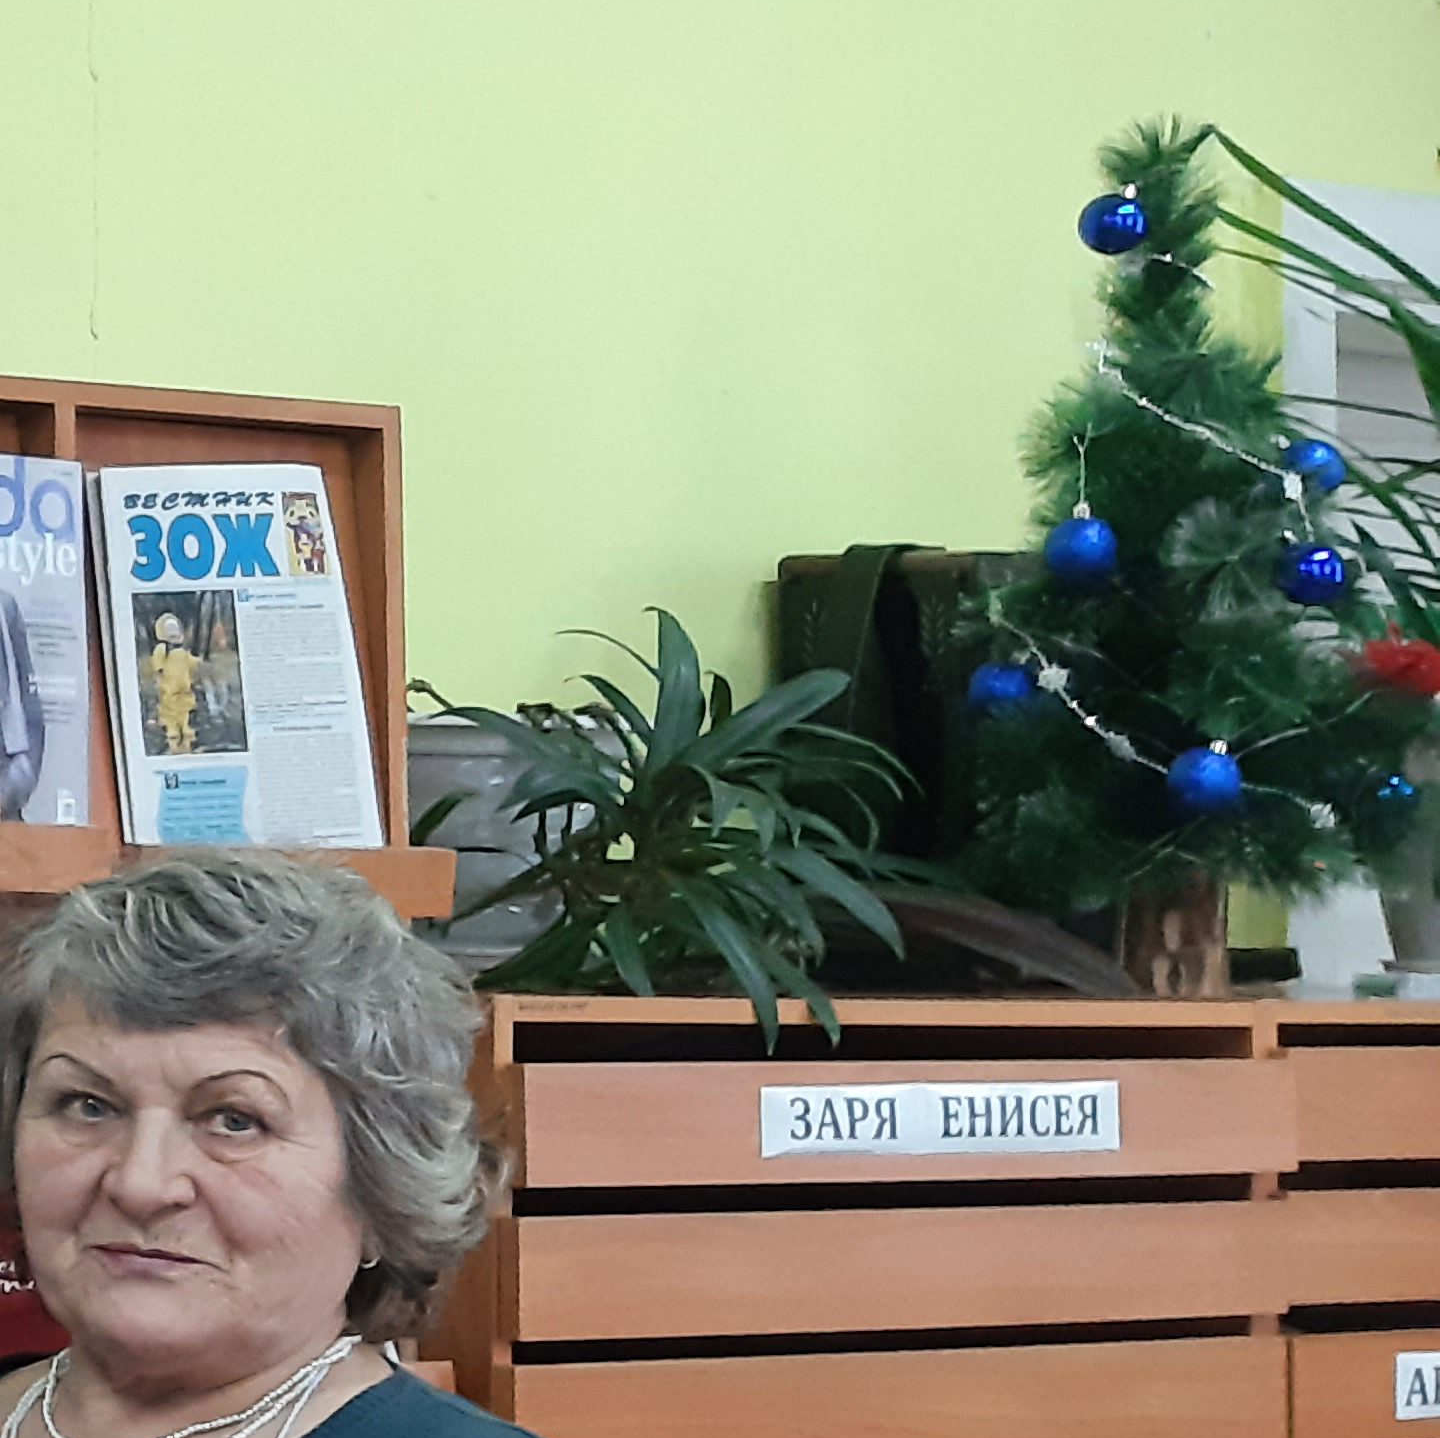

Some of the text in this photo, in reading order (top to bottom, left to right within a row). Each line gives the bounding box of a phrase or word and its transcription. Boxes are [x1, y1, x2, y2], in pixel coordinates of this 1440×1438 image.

[123, 491, 275, 510] ВЕСТНИК
[128, 513, 280, 581] ЗОЖ
[788, 1093, 1101, 1143] ЗАРЯ ЕНИСЕЯ
